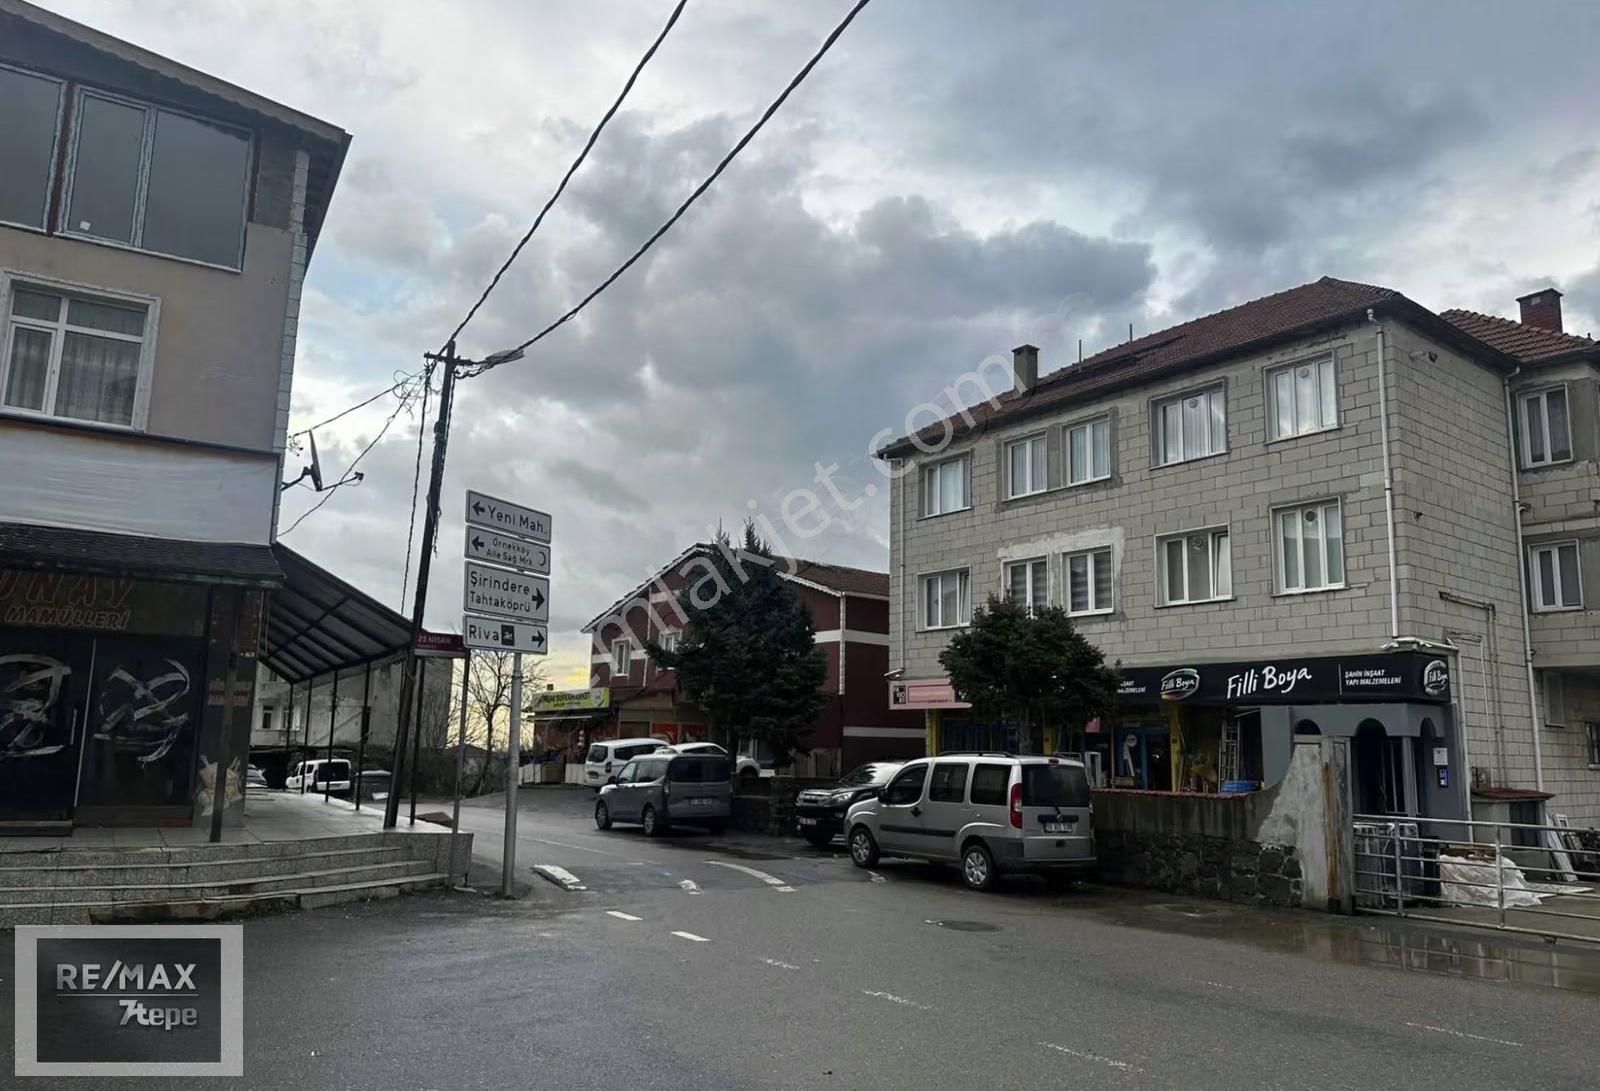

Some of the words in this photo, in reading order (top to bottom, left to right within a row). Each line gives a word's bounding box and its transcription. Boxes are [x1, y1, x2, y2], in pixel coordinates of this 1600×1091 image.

[488, 504, 516, 525] Yeni
[519, 514, 548, 534] Mah.
[470, 571, 530, 595] Şirindere
[469, 591, 530, 613] Tahtaköprü
[469, 624, 500, 641] Riva
[1161, 679, 1175, 691] Filli
[1176, 677, 1195, 691] Boya
[1226, 669, 1258, 699] Filli
[1263, 665, 1312, 693] Boya
[1345, 678, 1360, 686] YAPI
